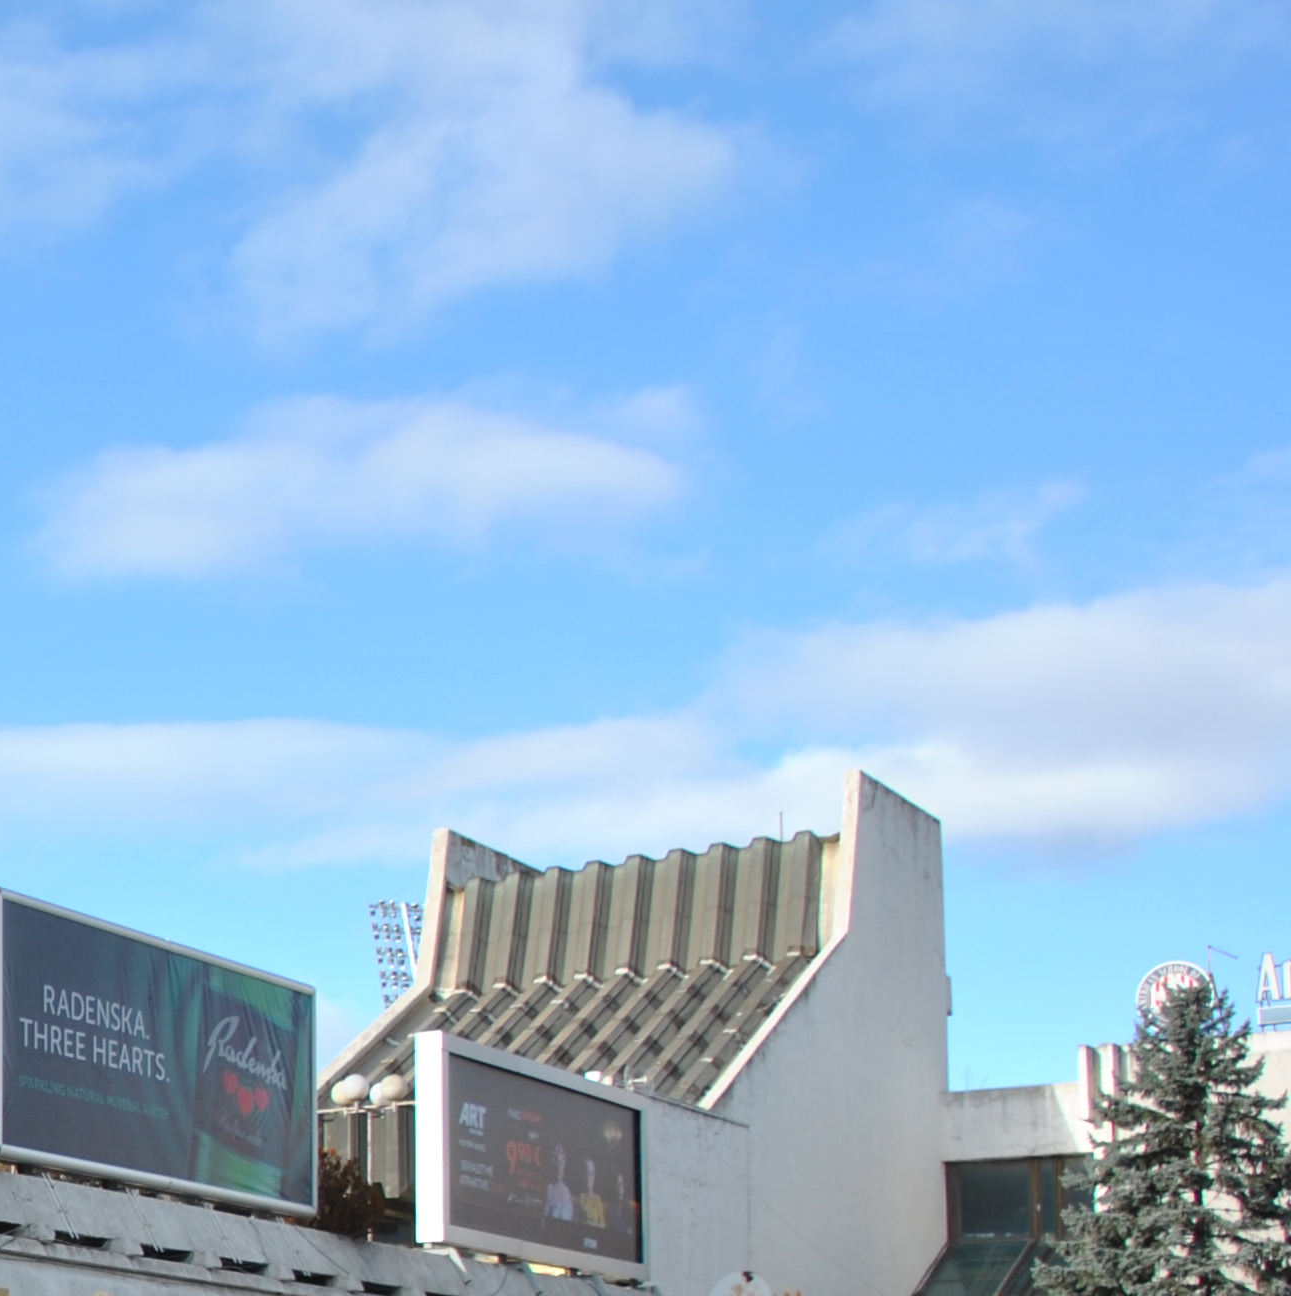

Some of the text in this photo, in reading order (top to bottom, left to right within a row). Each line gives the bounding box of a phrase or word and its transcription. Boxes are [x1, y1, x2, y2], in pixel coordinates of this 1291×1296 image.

[43, 984, 150, 1040] RADENSKA.
[19, 1017, 170, 1083] THREE HEARTS.
[458, 1101, 487, 1130] ART
